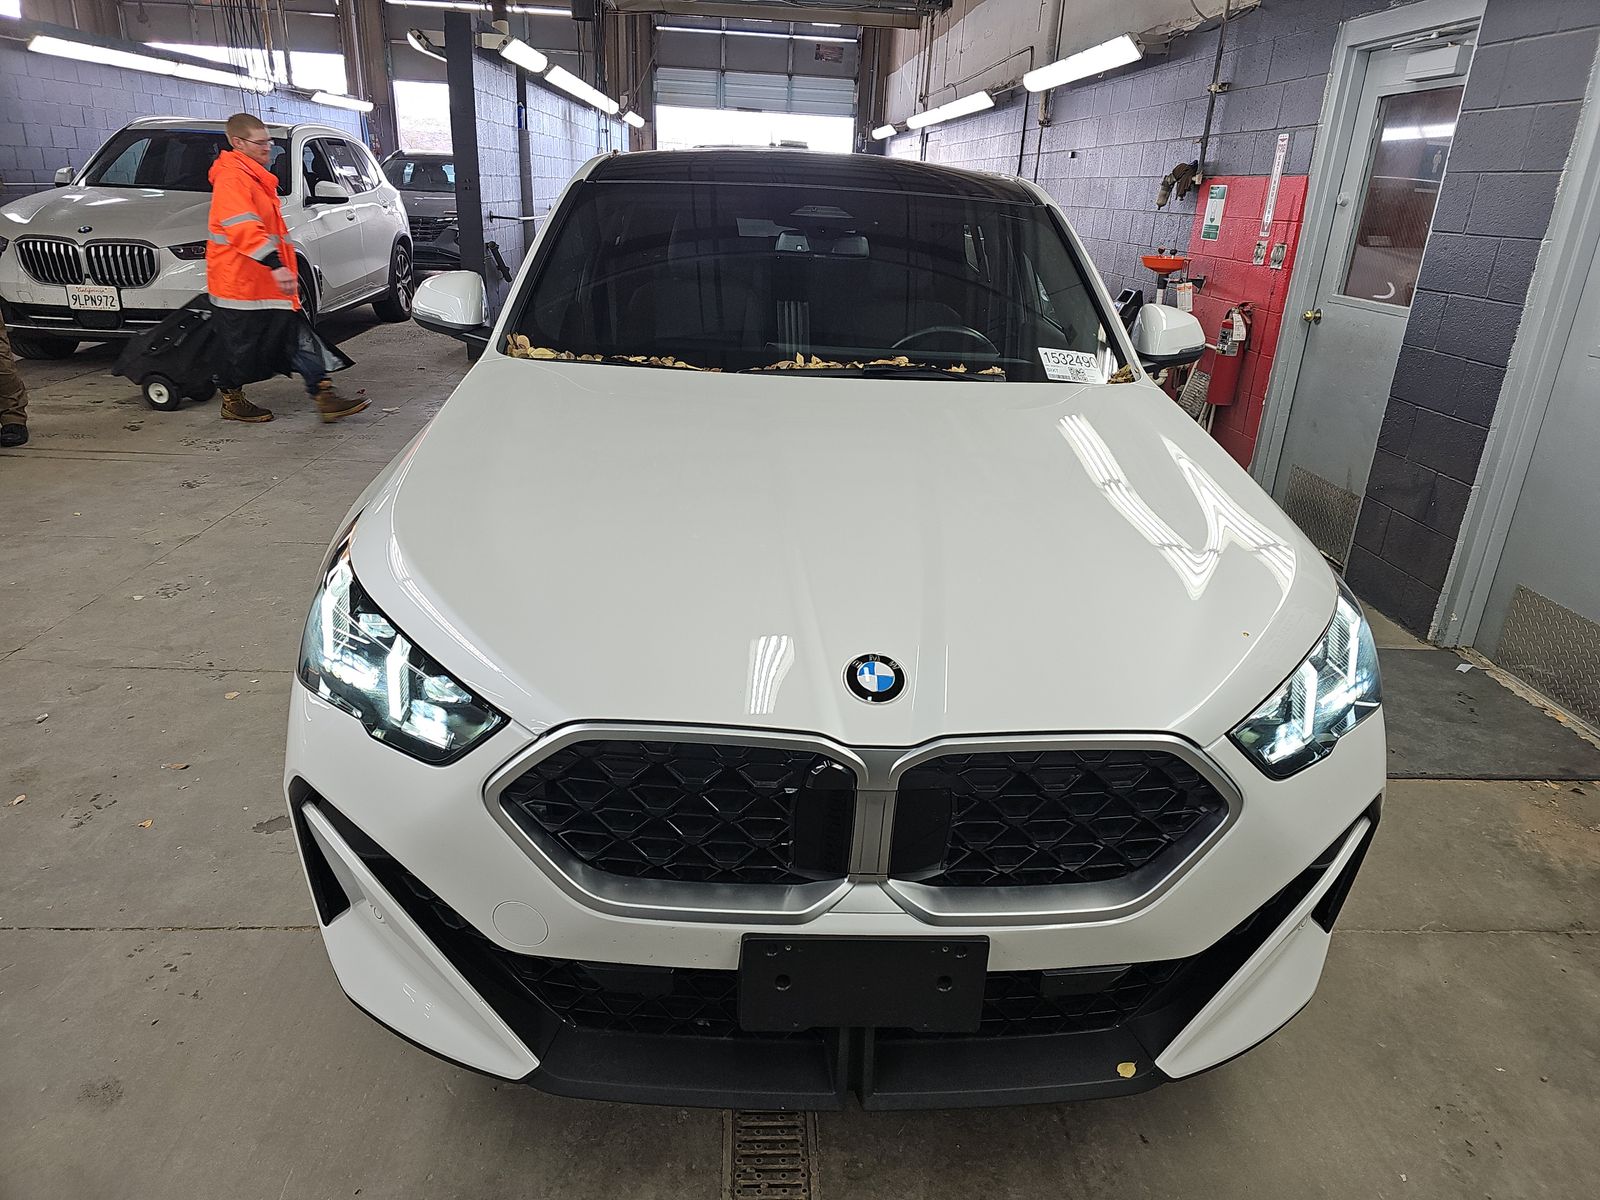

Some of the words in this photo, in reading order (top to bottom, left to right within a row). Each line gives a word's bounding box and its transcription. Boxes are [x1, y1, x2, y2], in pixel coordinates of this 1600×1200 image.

[71, 294, 116, 308] 9LPN972
[1043, 351, 1098, 368] 1532490
[851, 654, 901, 671] BMW
